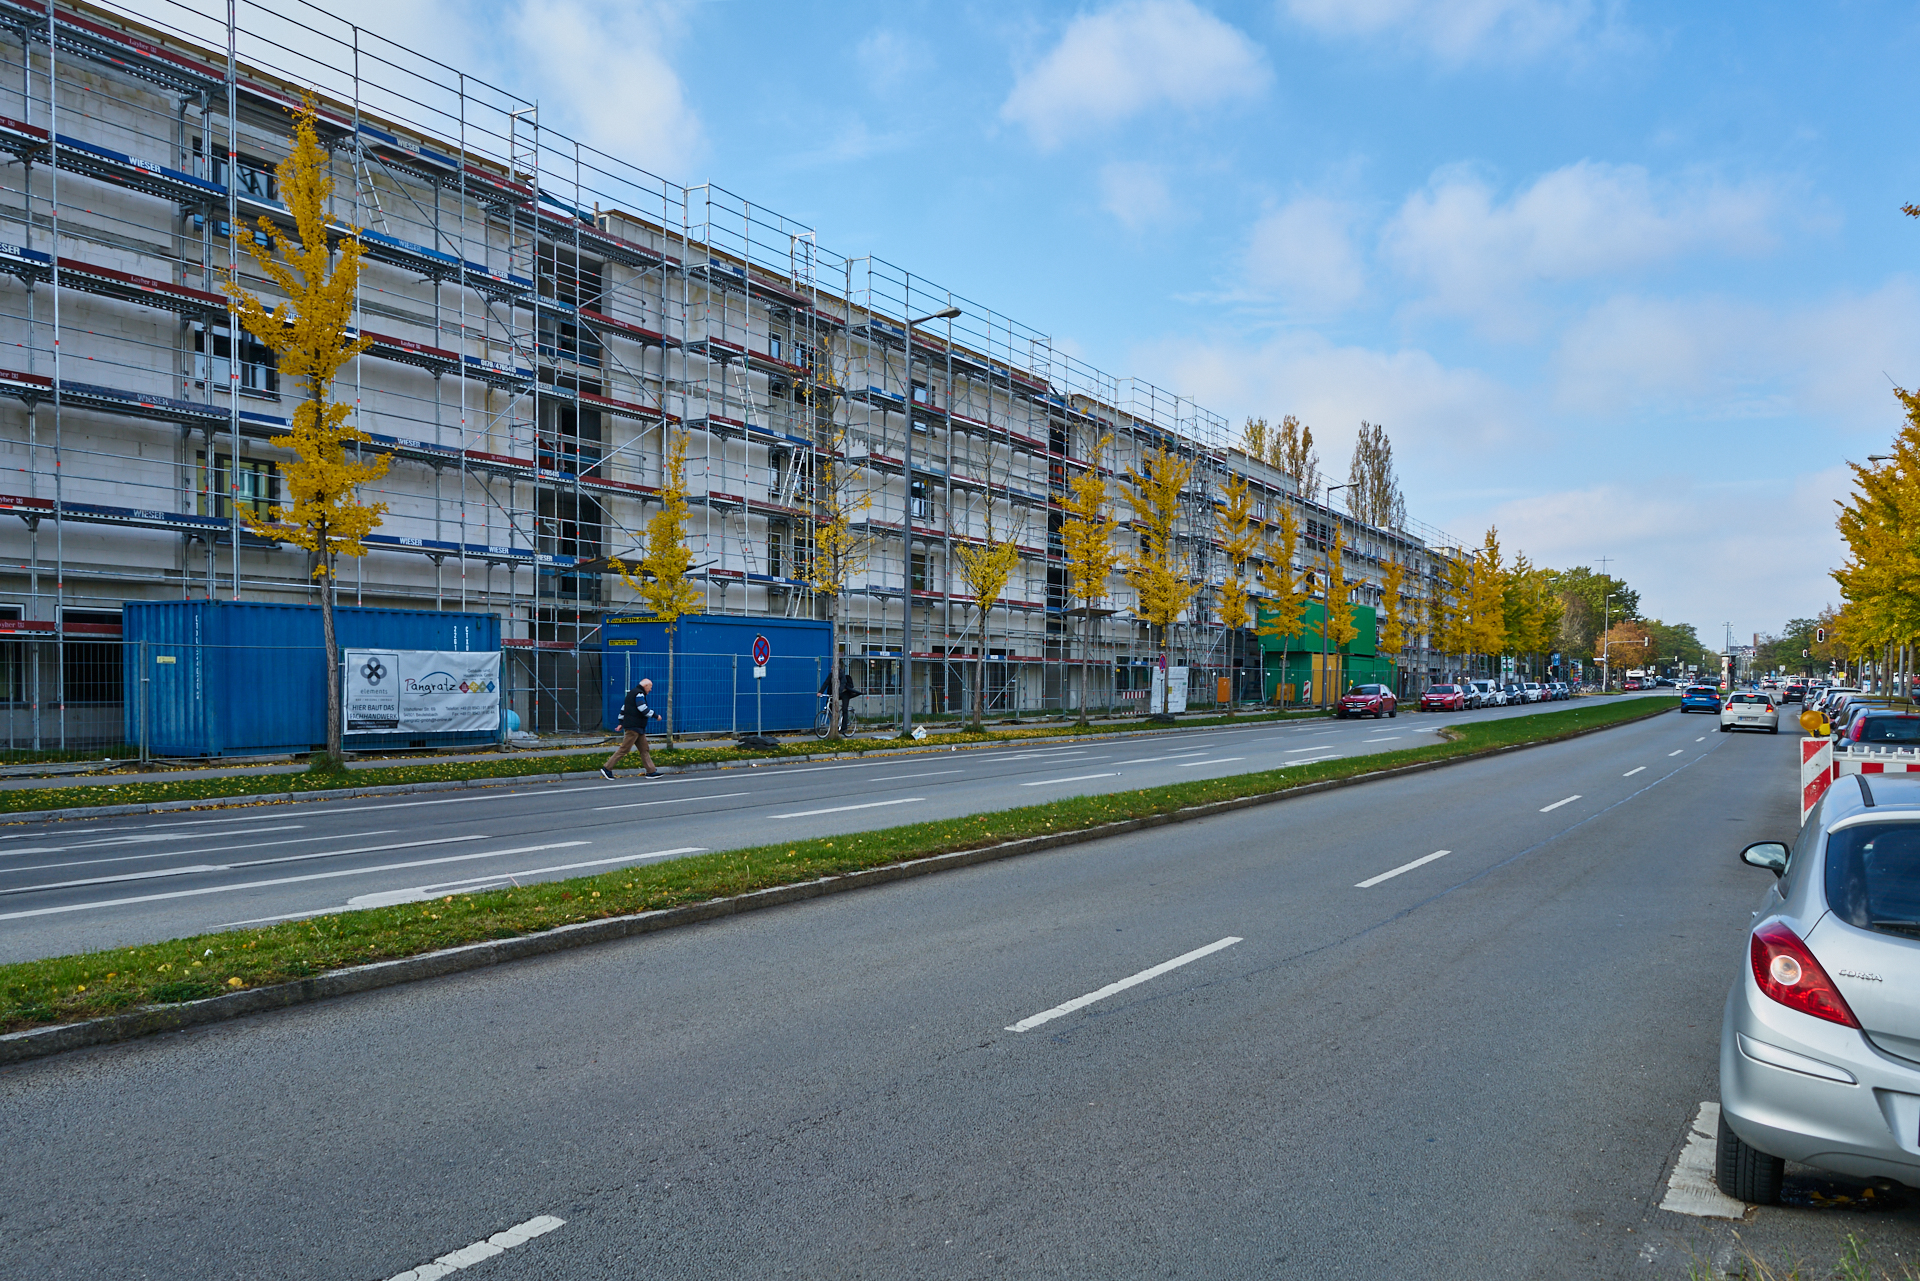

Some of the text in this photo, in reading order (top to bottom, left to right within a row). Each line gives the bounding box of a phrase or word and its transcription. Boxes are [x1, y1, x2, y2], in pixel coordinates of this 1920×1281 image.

[396, 138, 421, 153] WIESER
[128, 156, 161, 174] WIESER
[398, 240, 422, 253] WIESER
[488, 268, 509, 280] WIESER
[136, 394, 169, 408] WIESER
[397, 438, 421, 449] WIESER
[133, 509, 164, 520] WIESER
[398, 537, 422, 547] WIESER
[488, 546, 510, 555] WIESER
[404, 677, 458, 697] Pangratz
[1838, 968, 1883, 982] CORSA
